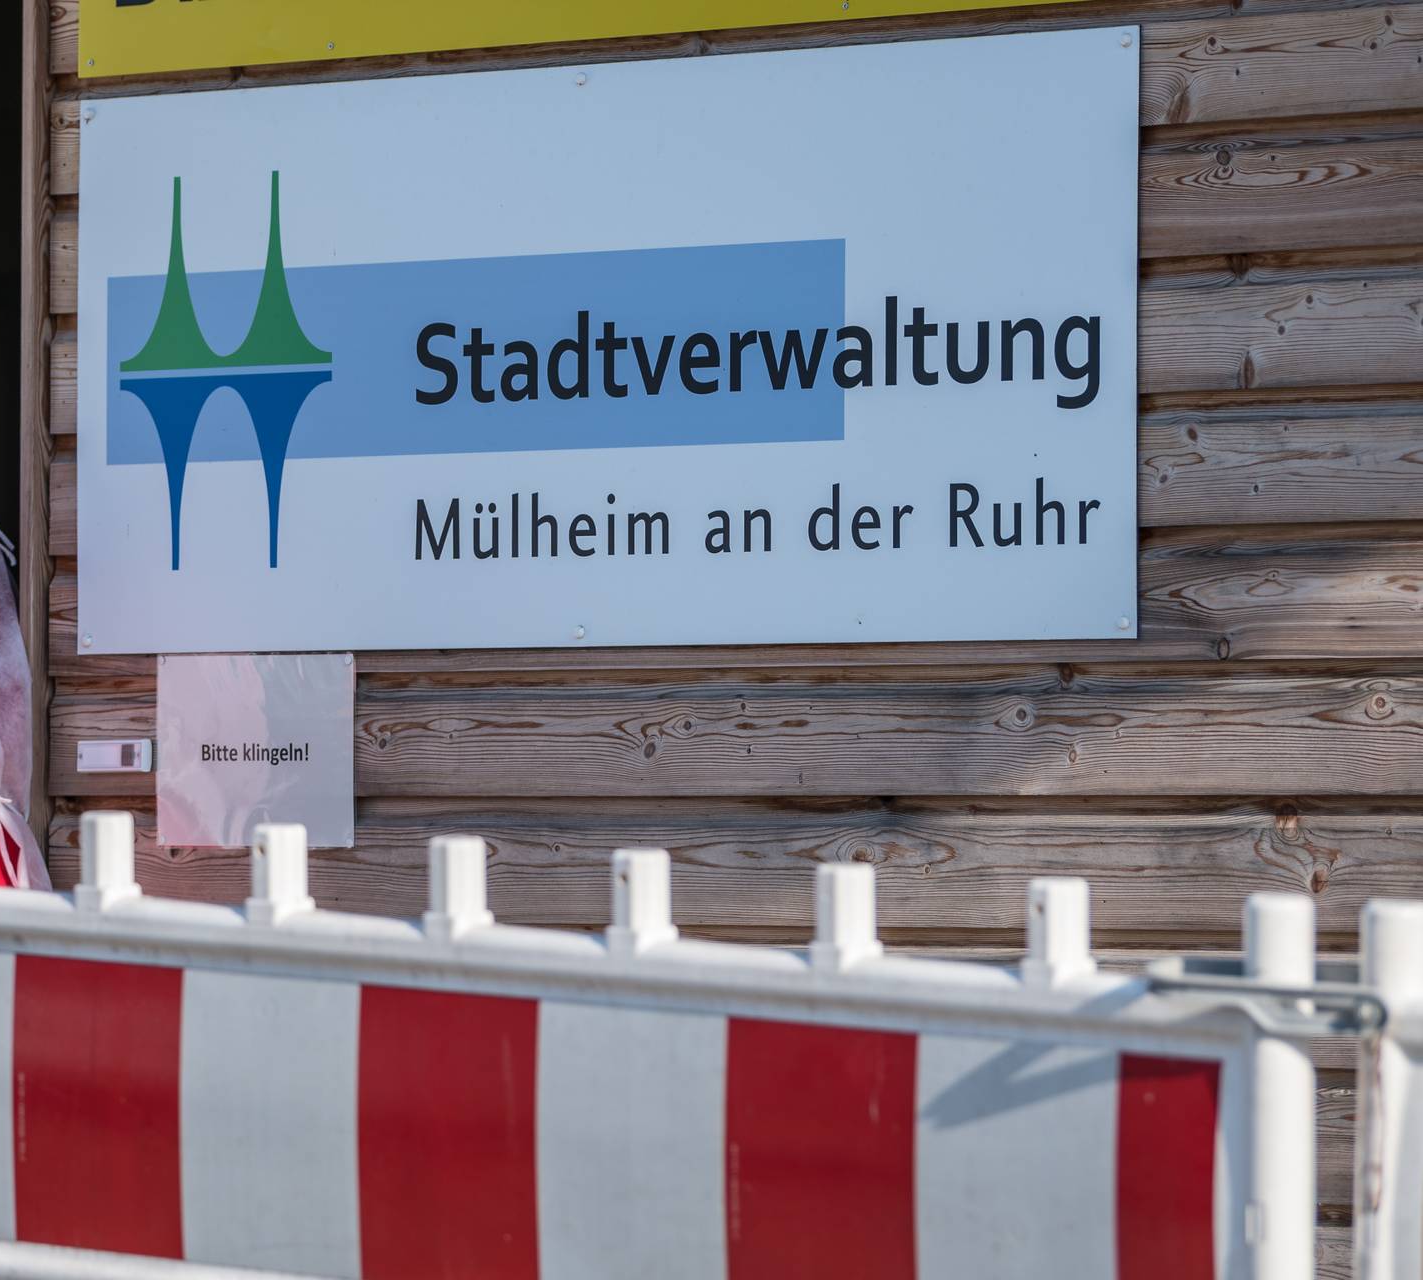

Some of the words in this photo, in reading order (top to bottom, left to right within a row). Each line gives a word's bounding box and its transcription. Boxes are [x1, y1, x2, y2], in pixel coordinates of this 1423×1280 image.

[416, 296, 1100, 409] Stadtverwaltung
[415, 492, 669, 560] Mülheim
[705, 509, 771, 554] an
[808, 483, 914, 551] der
[949, 477, 1101, 548] Ruhr
[202, 744, 238, 762] Bitte
[243, 742, 309, 766] klingeln!
